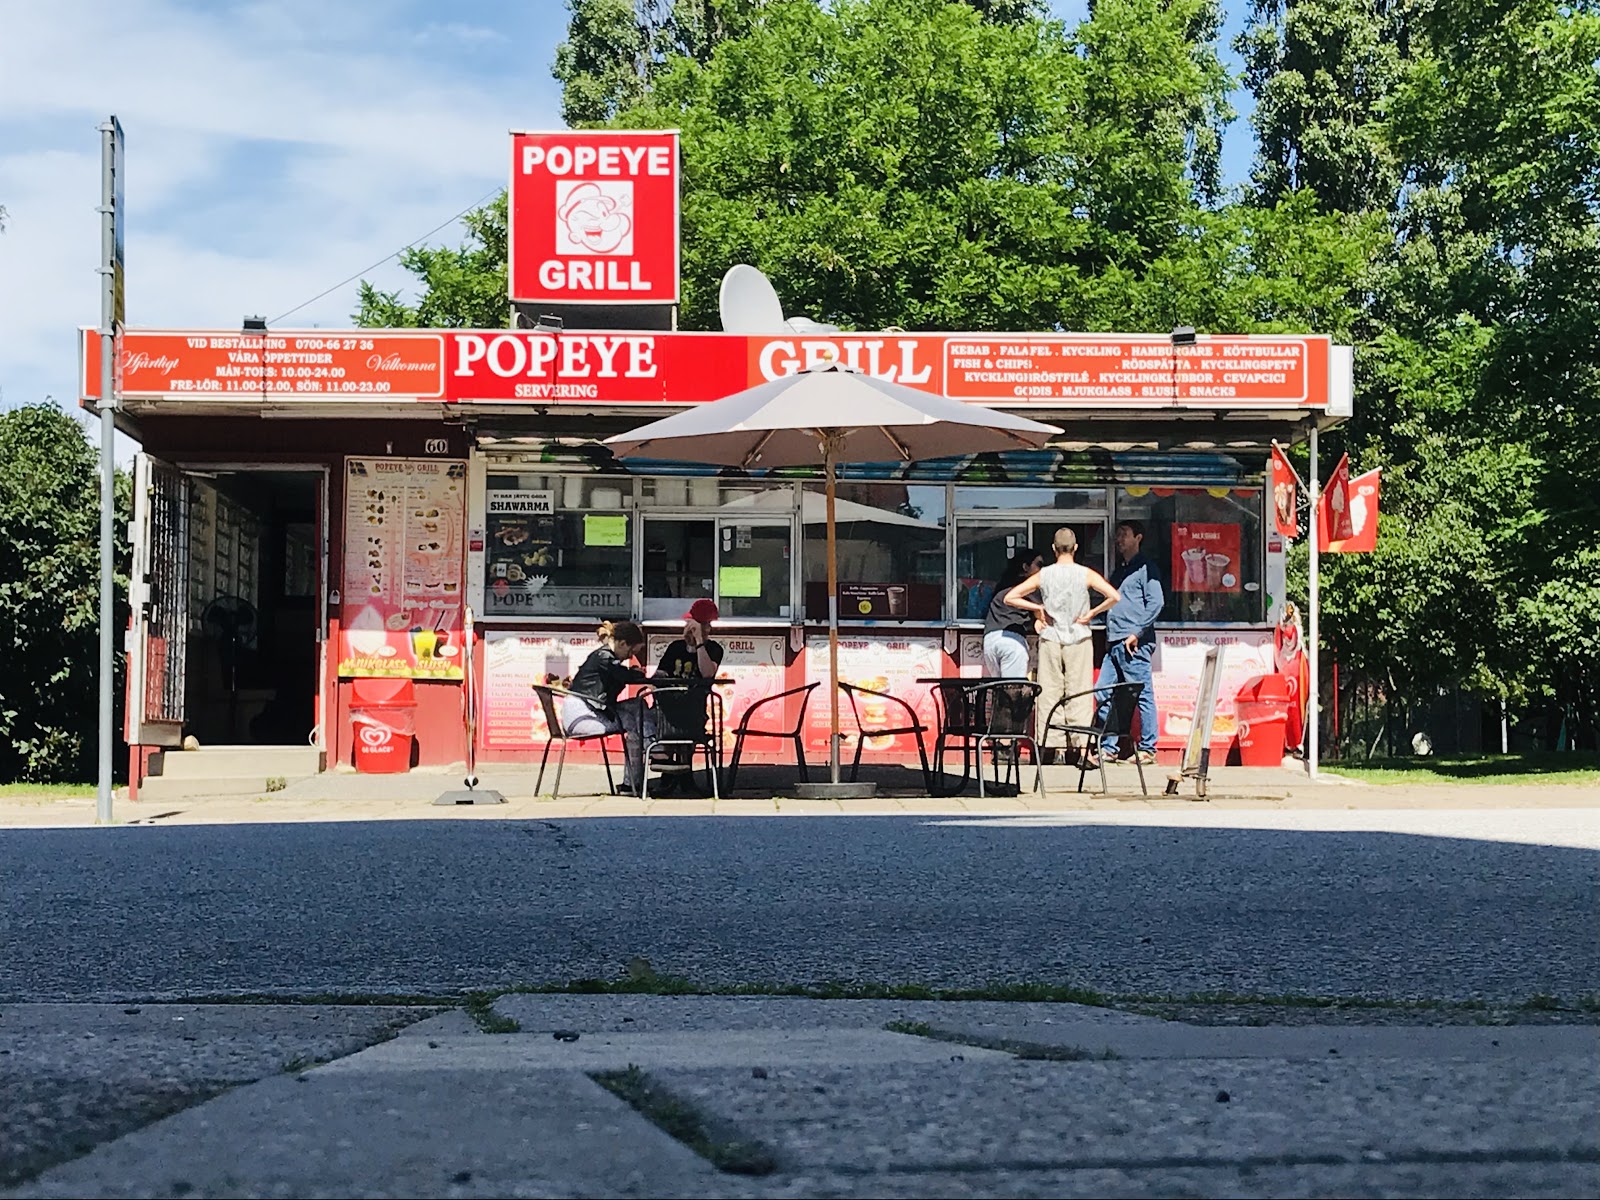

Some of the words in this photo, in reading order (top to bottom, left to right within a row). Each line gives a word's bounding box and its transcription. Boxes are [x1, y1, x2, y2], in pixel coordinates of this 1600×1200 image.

[523, 146, 670, 176] POPEYE
[539, 260, 652, 291] GRILL
[187, 338, 208, 349] VID
[210, 337, 287, 350] BESTÄLLNING
[295, 339, 341, 351] 0700-66
[343, 340, 357, 350] 27
[359, 340, 374, 350] 36
[228, 351, 260, 363] VÅRA
[262, 352, 333, 364] ÖPPETTIDER
[951, 345, 990, 356] KEBAB
[1000, 346, 1052, 356] FALAFEL
[1062, 346, 1121, 356] KYCKLING
[1131, 346, 1213, 357] HAMBURGARE
[1223, 345, 1300, 357] KÖTTBULLAR
[122, 350, 180, 376] Hjärtligt
[366, 353, 436, 372] Välkomna
[454, 335, 658, 378] POPEYE
[759, 340, 933, 384] GRILL
[953, 359, 981, 369] FISH
[983, 359, 993, 369] &
[996, 359, 1032, 369] CHIPS
[1122, 358, 1191, 370] RÖDSPÄTTA
[1201, 360, 1297, 370] KYCKLINGSPETT
[216, 364, 278, 377] MÅN-TORS:
[281, 367, 346, 378] 10.00-24.00
[1099, 373, 1213, 383] KYCKLINGKLUBBOR
[1223, 373, 1286, 383] CEVAPCICI
[170, 379, 223, 391] FRE-LÖR:
[296, 380, 323, 392] SÖN:
[326, 381, 390, 392] 11.00-23.00
[515, 383, 598, 398] SERVERING
[1014, 386, 1052, 396] GODIS
[1062, 386, 1132, 396] MJUKGLASS
[1141, 386, 1179, 396] SLUSH
[1189, 386, 1236, 396] SNACKS
[427, 440, 446, 453] 60
[375, 463, 403, 473] POPEYE
[416, 464, 439, 474] GRILL
[490, 501, 550, 511] SHAWARMA
[578, 593, 625, 606] GRILL
[729, 641, 755, 650] GRILL
